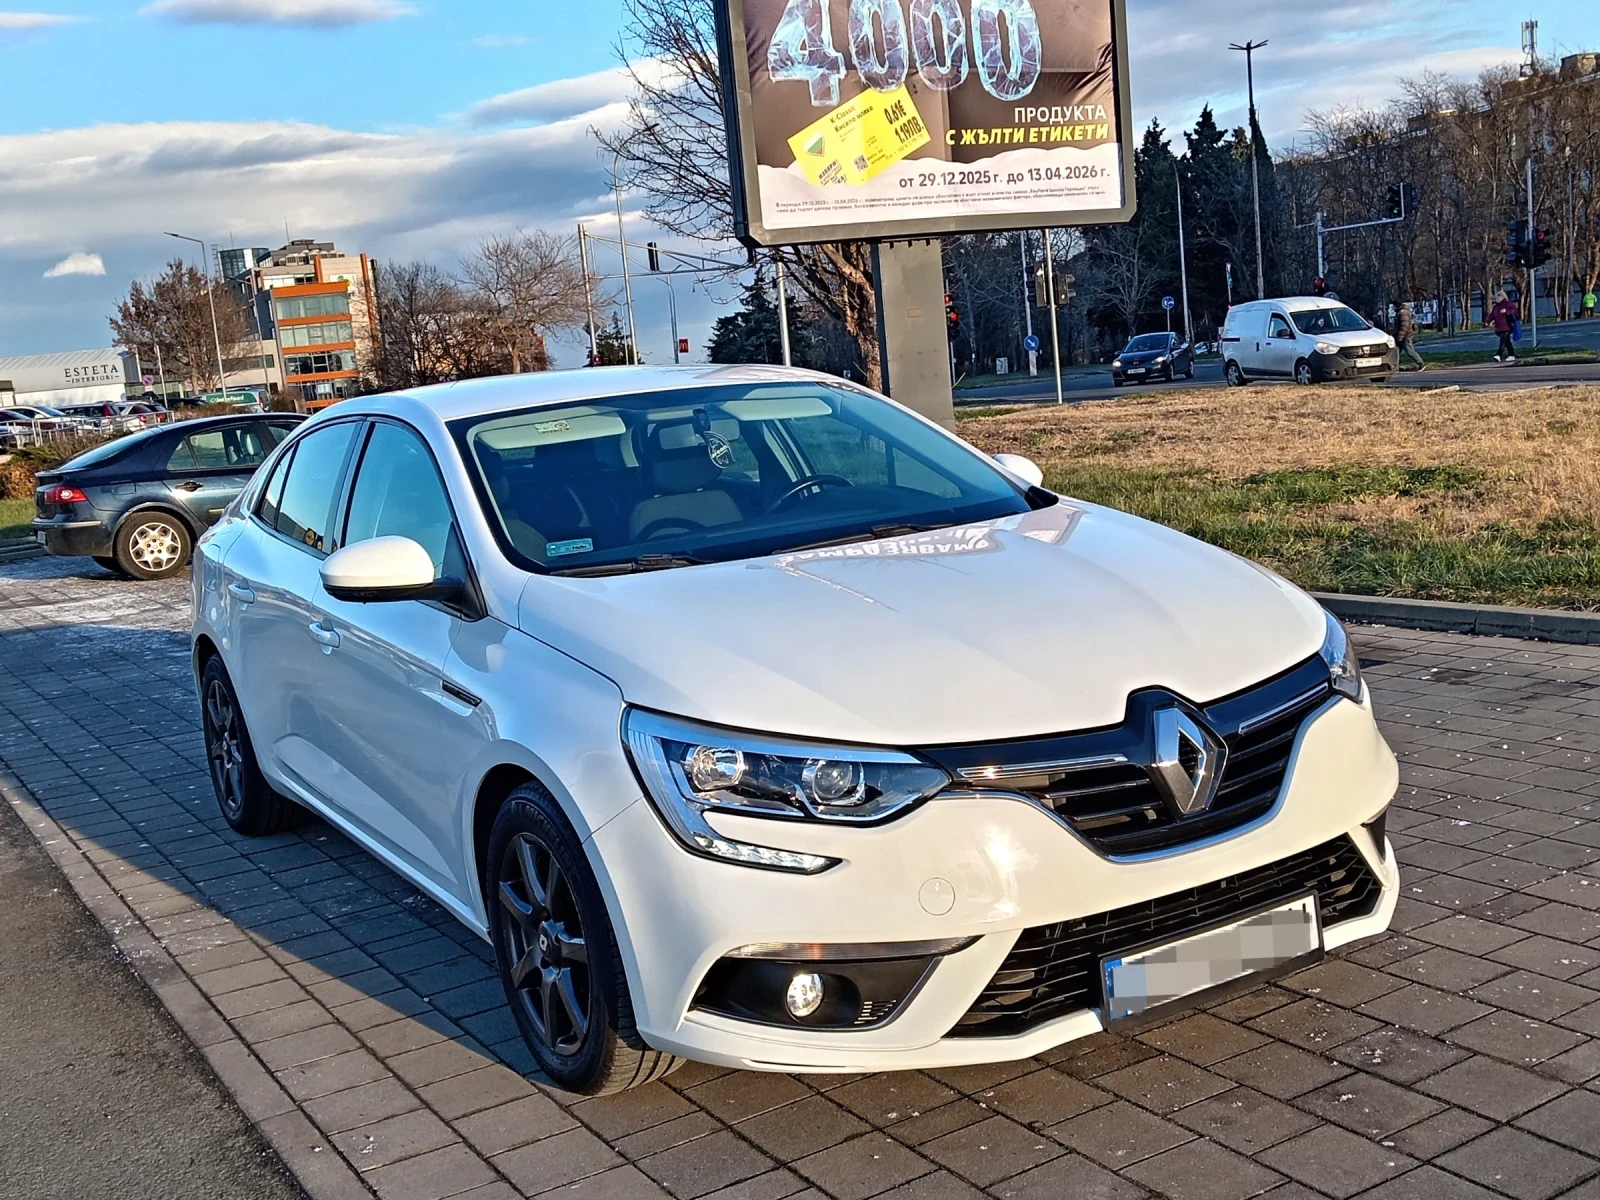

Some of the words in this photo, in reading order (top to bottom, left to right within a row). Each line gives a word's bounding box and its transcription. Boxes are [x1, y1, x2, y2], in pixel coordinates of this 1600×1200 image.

[767, 0, 1041, 107] 4000
[835, 117, 857, 132] Кисело
[857, 106, 873, 119] мляко
[884, 100, 907, 125] 0.61€
[1014, 105, 1107, 124] ПРОДУКТА
[945, 130, 956, 145] С
[960, 128, 1025, 145] ЖЪЛТИ
[1029, 124, 1109, 142] ЕТИКЕТИ
[899, 177, 914, 188] от
[918, 170, 991, 187] 29.12.2025
[993, 173, 1003, 183] г.
[1006, 172, 1024, 184] до
[1027, 165, 1098, 181] 13.04.2026
[1100, 168, 1110, 178] г.
[64, 364, 118, 378] ESTETA
[525, 804, 573, 869] MICHELIN
